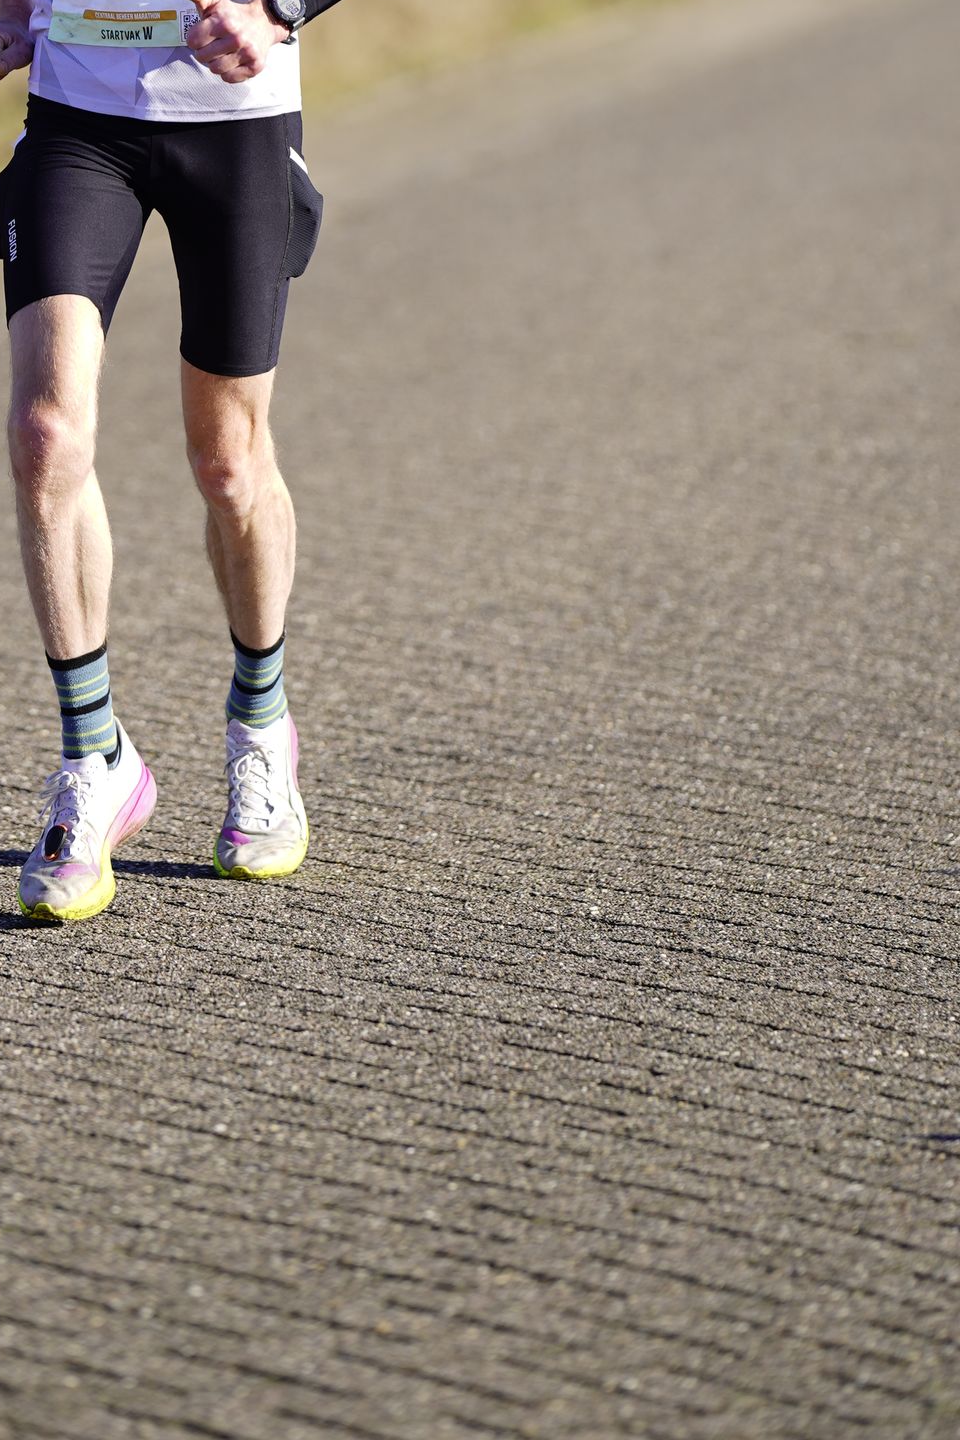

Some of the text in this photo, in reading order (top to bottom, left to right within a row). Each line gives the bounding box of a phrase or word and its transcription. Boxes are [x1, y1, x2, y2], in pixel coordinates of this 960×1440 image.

[134, 12, 161, 21] MARATHON
[101, 26, 153, 40] STARTVAK W
[7, 218, 18, 262] FUSION
